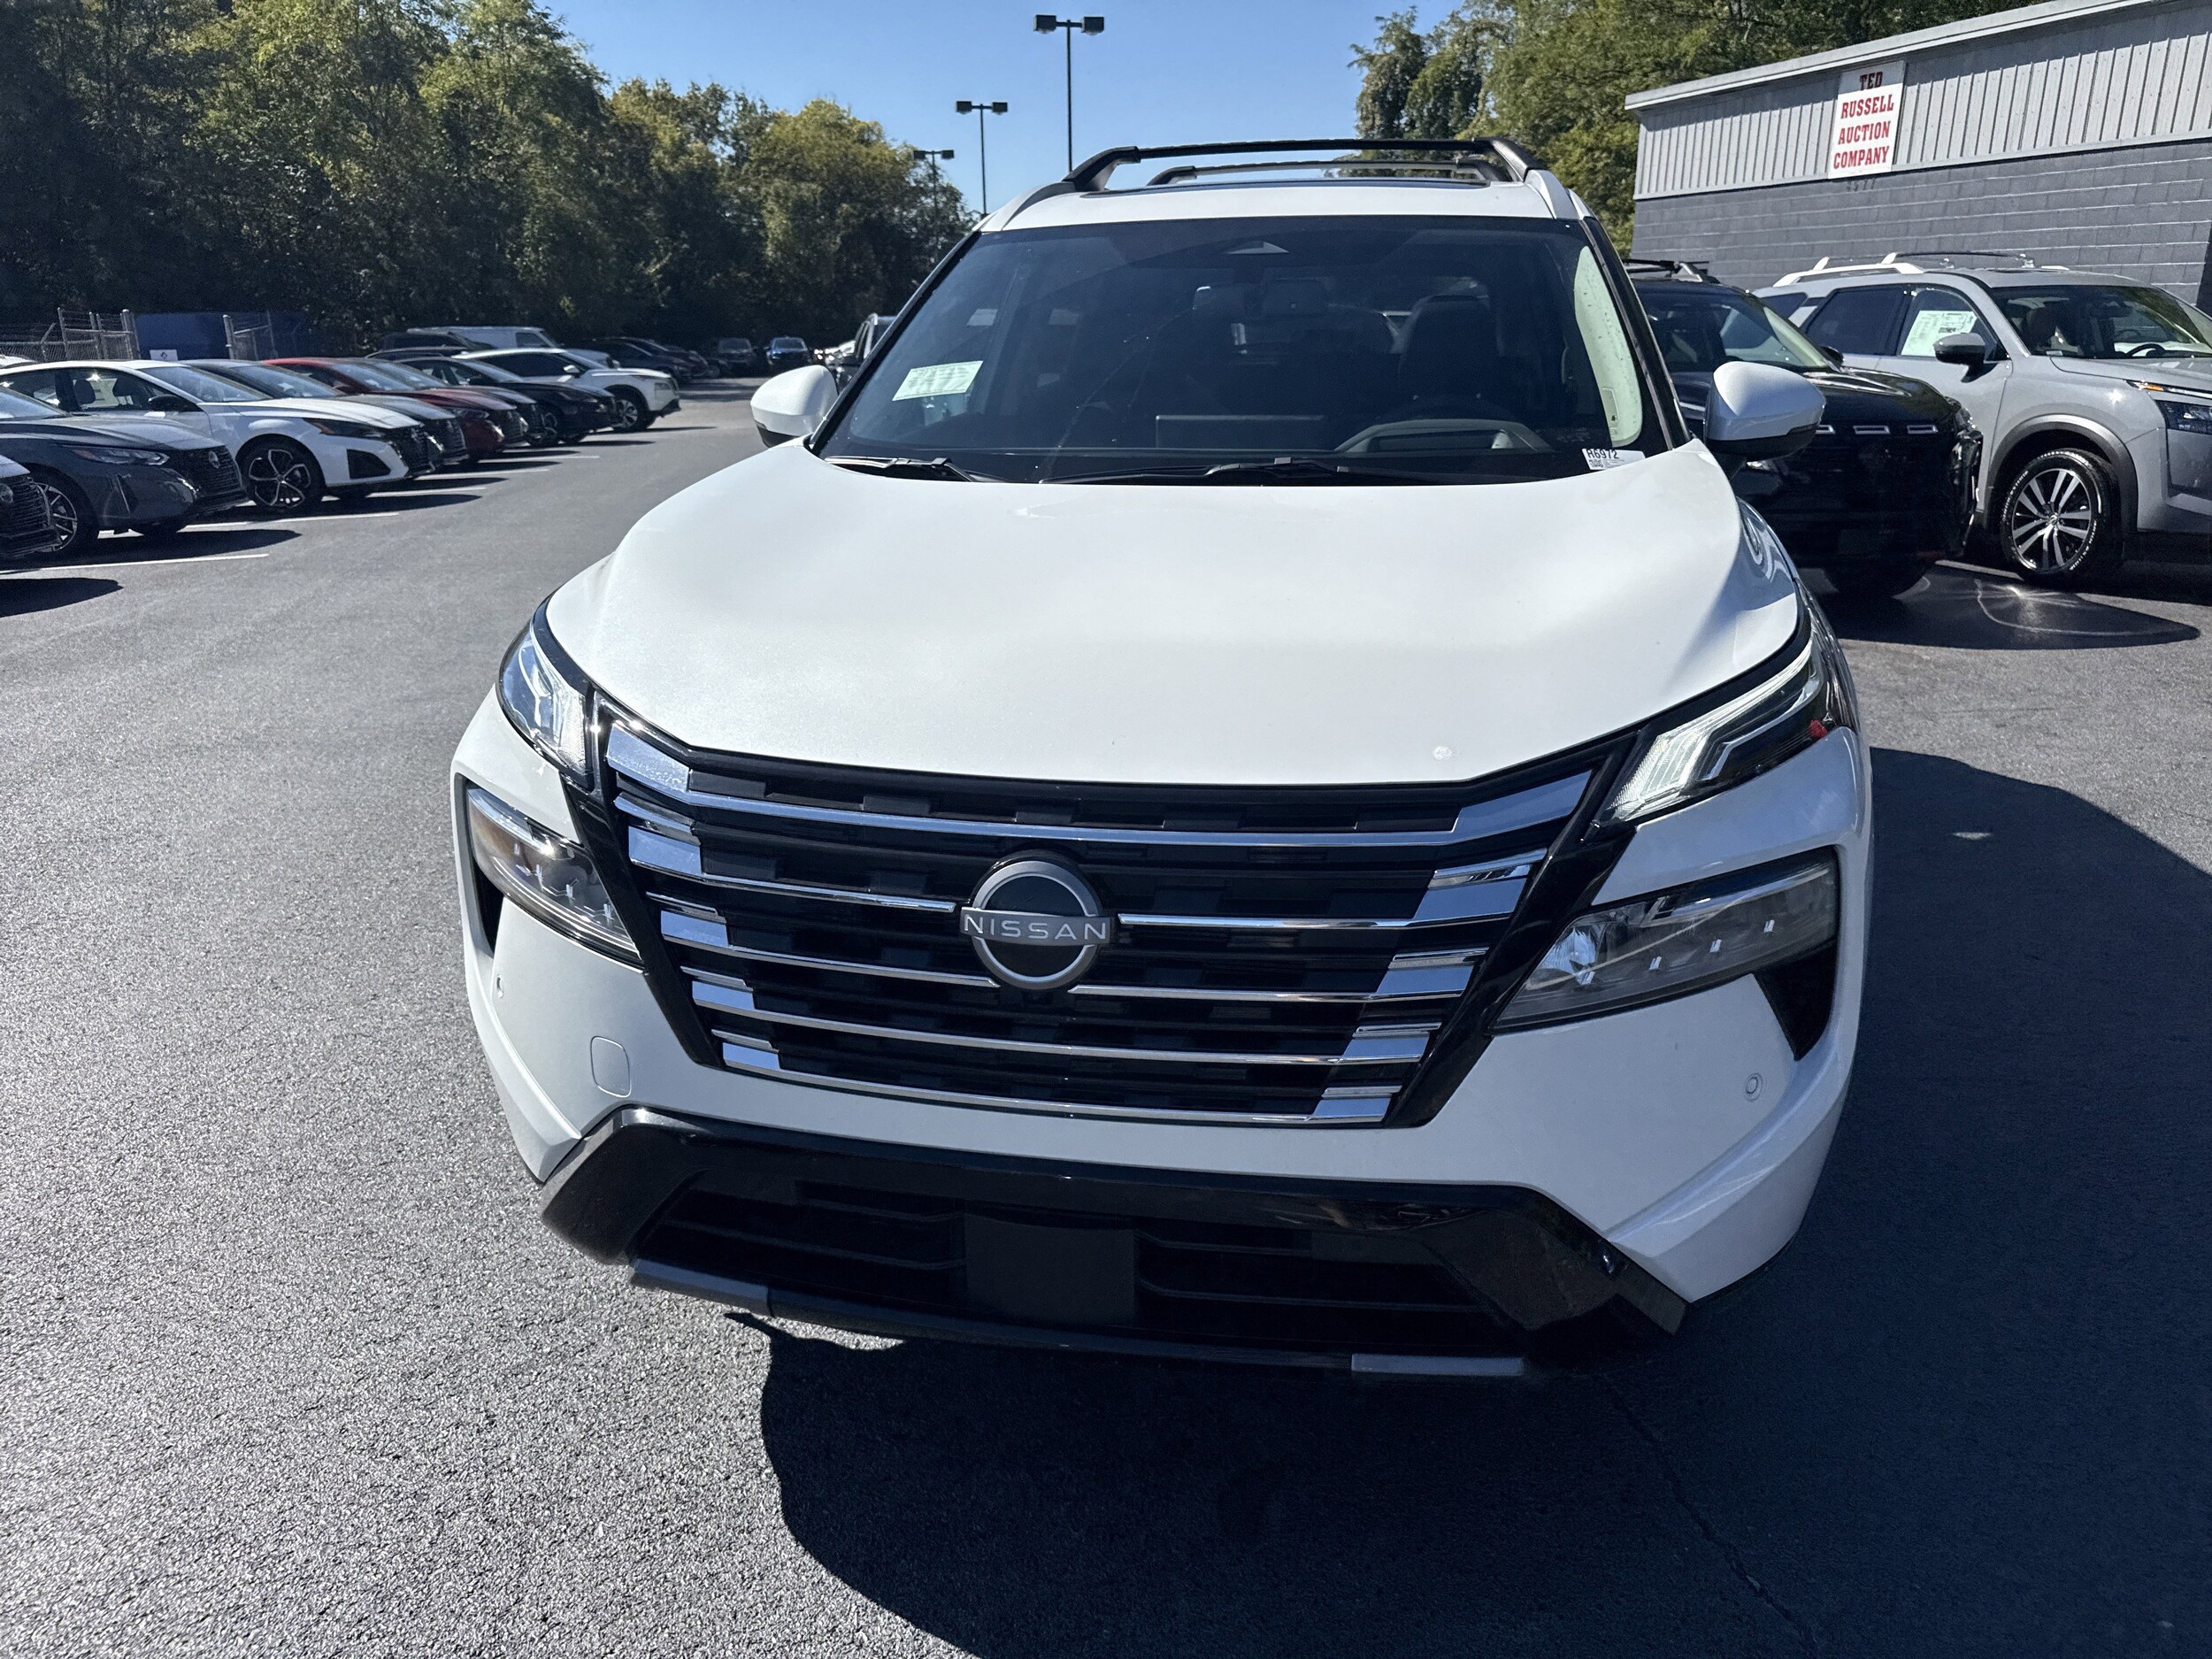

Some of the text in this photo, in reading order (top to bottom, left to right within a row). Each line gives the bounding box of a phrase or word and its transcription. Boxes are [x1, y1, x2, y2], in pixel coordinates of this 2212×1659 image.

[1859, 71, 1883, 90] TED
[1840, 94, 1894, 119] RUSSELL
[1838, 120, 1891, 145] AUCTION
[1833, 145, 1890, 170] COMPANY
[1586, 448, 1619, 459] R6972
[964, 913, 1106, 941] NISSAN
